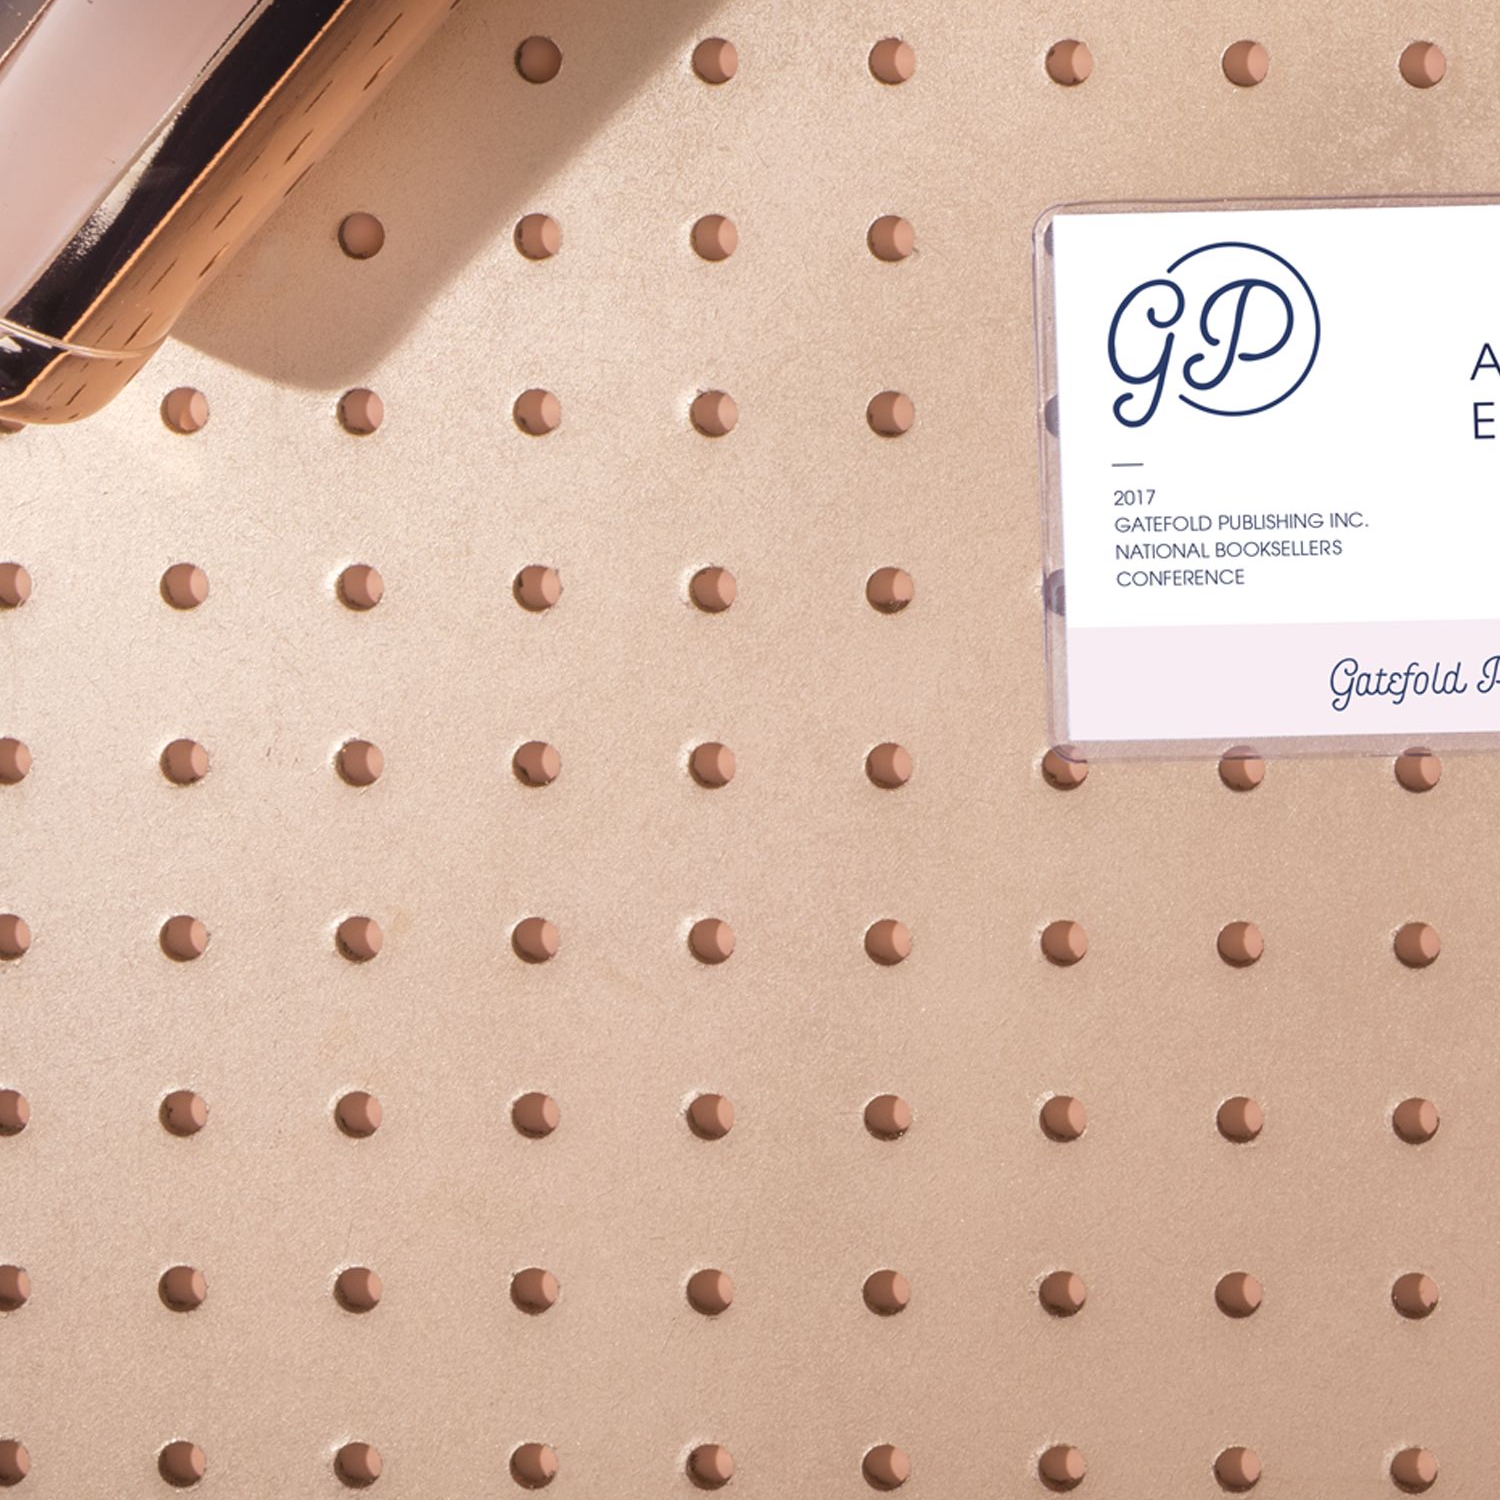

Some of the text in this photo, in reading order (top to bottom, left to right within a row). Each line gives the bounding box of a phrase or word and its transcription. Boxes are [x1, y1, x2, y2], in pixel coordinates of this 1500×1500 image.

[1113, 488, 1156, 506] 2017
[1114, 511, 1369, 534] GATEFOLD PUBLISHING INC.
[1115, 539, 1343, 560] NATIONAL BOOKSELLERS
[1116, 568, 1245, 587] CONFERENCE
[1329, 656, 1468, 712] Gatefold
